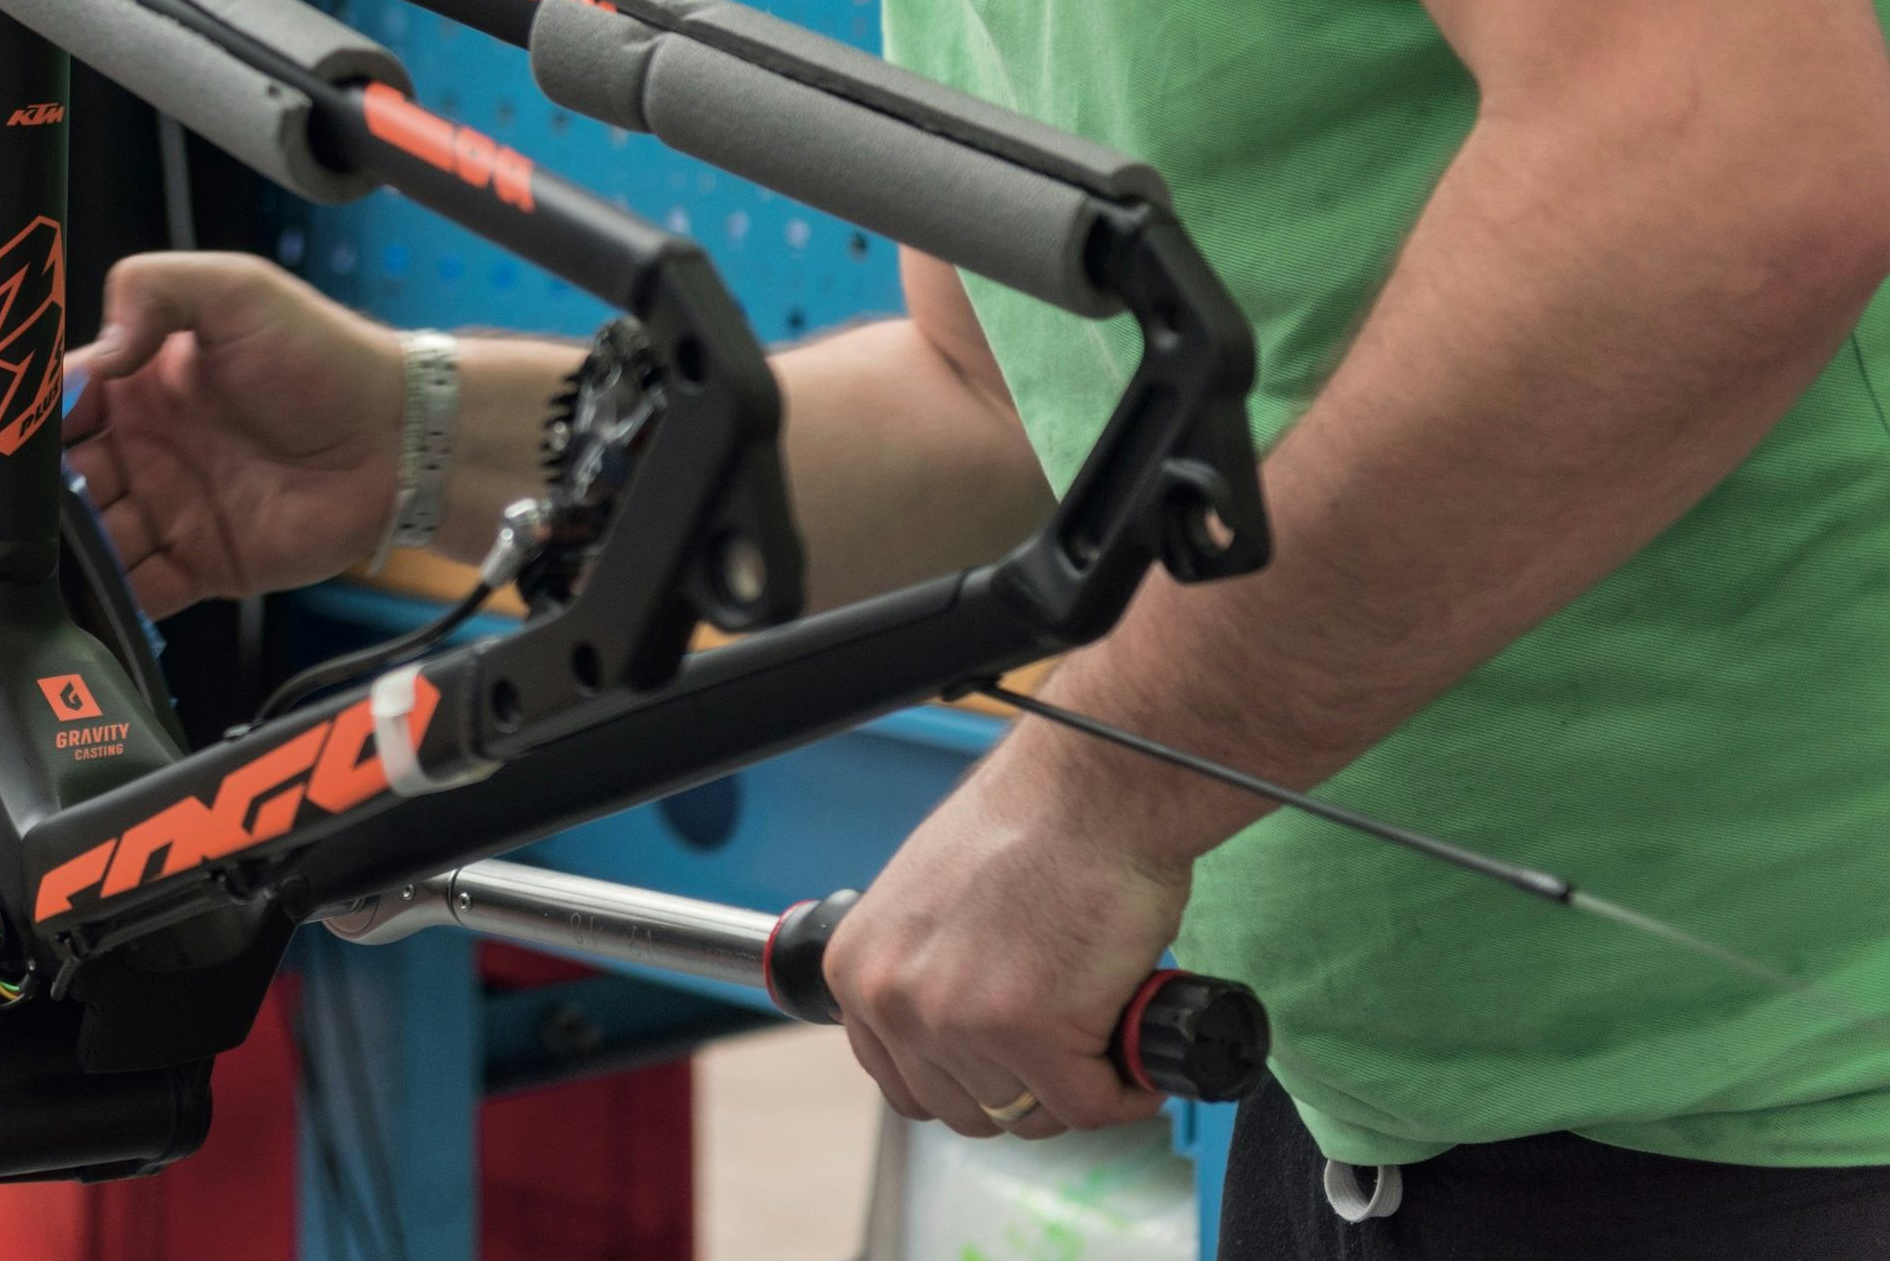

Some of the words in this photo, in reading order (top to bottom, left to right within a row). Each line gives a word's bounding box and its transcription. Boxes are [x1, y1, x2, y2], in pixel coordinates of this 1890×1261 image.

[6, 102, 66, 126] KTM
[55, 722, 130, 749] GRAVITY
[74, 743, 124, 761] CASTING
[35, 674, 441, 924] FOGO
